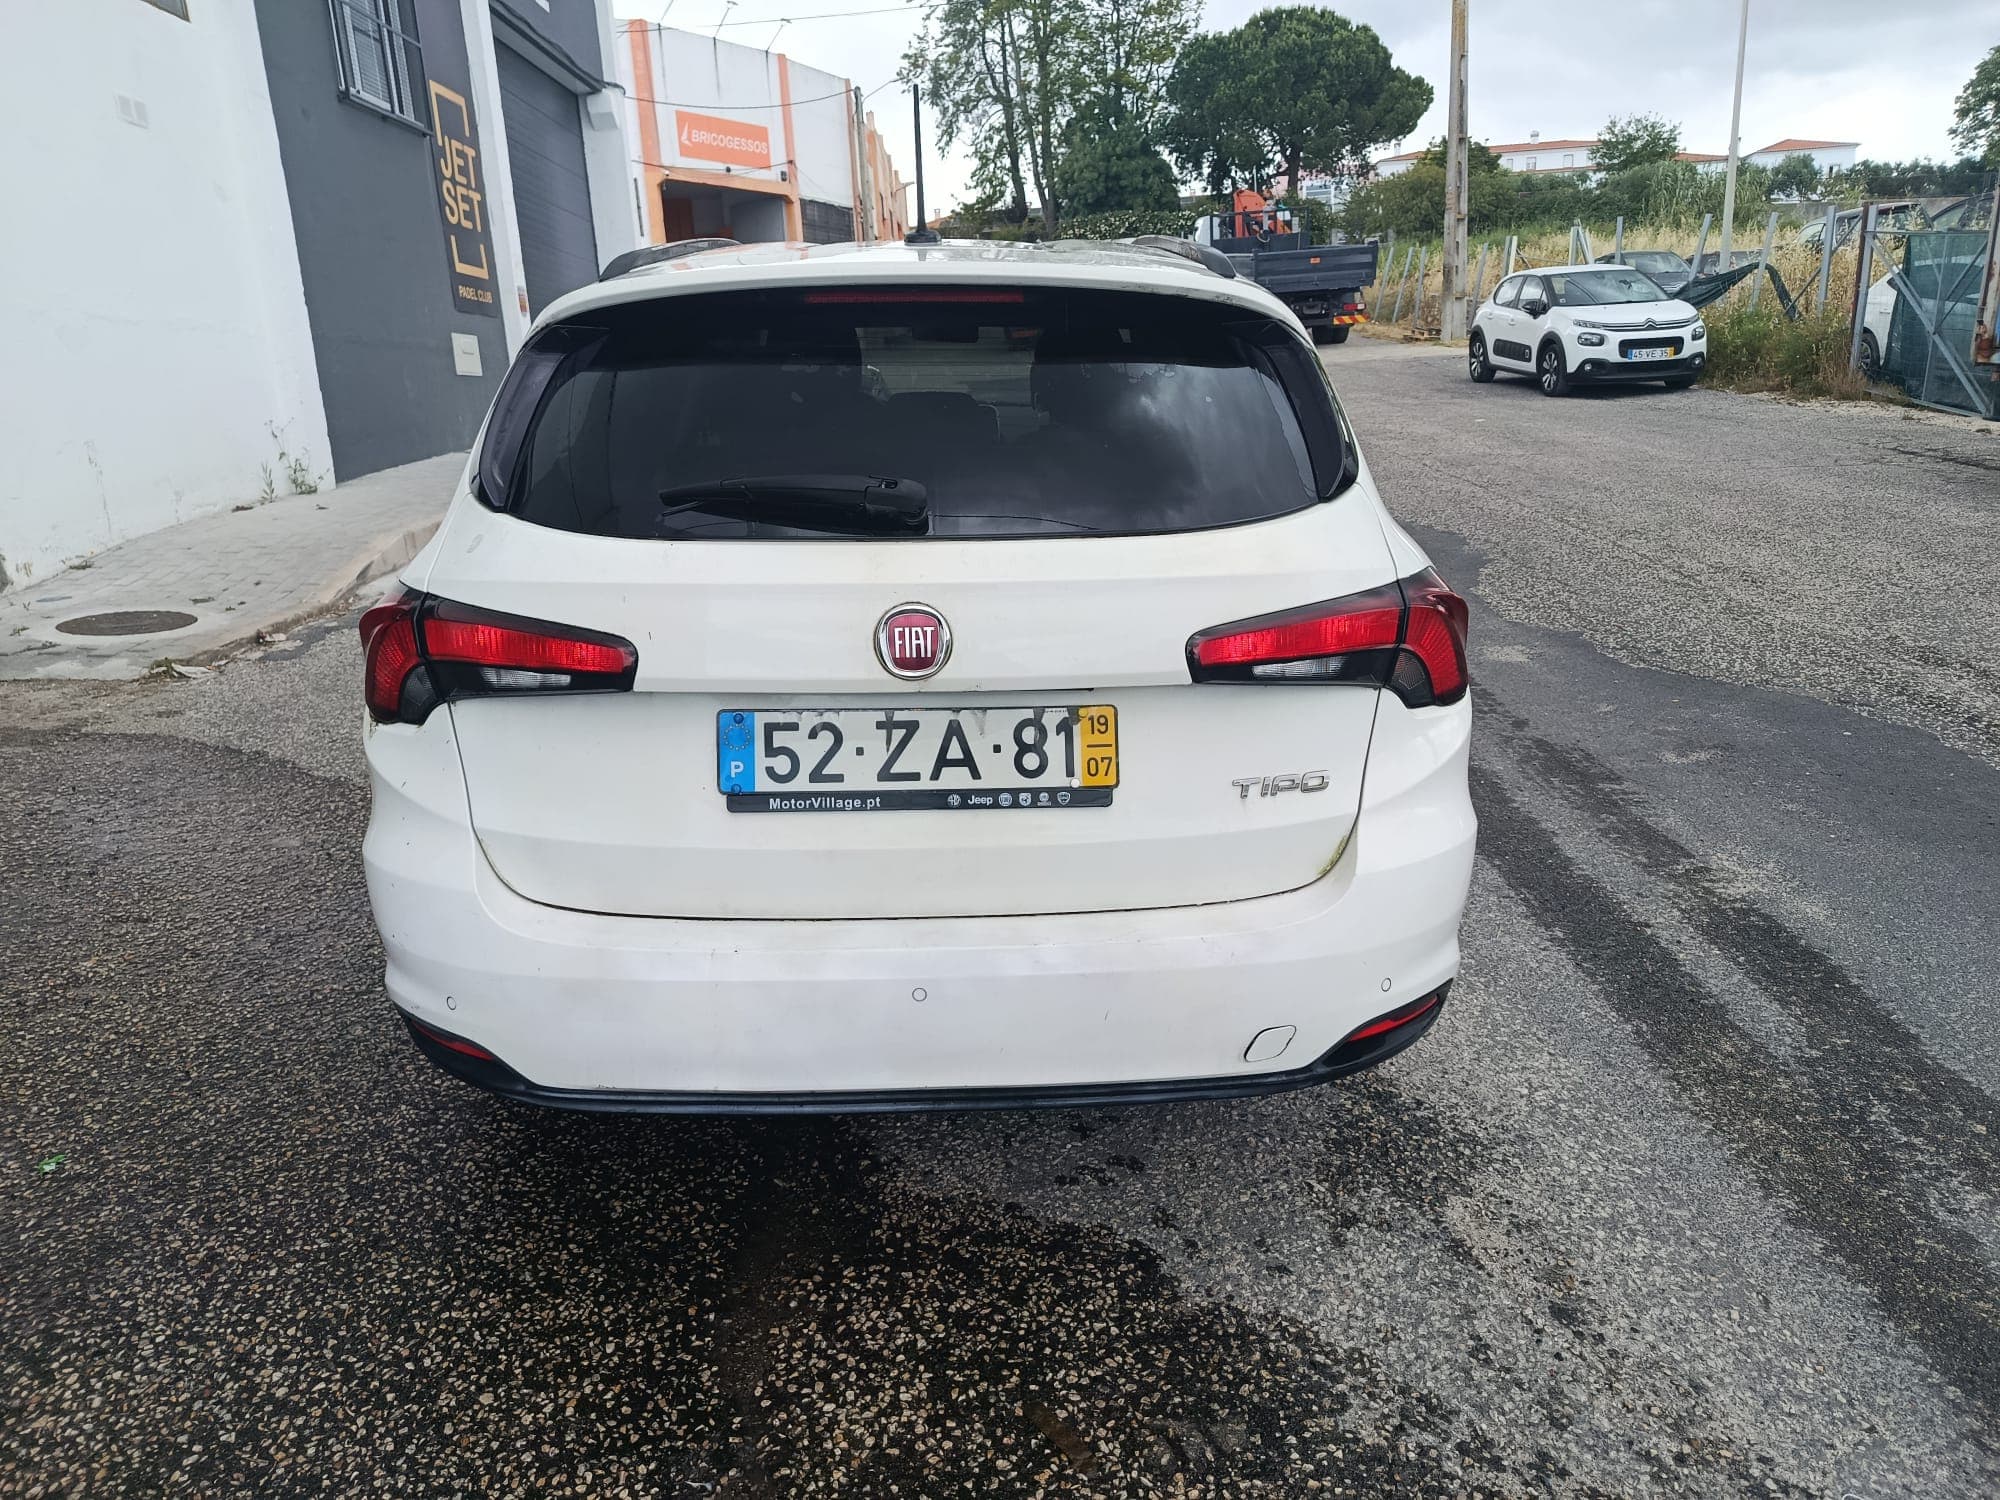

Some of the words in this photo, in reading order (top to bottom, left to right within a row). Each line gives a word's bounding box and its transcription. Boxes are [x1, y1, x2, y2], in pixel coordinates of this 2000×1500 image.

[691, 129, 768, 154] BRICOGESSOS
[440, 135, 476, 189] JET
[442, 179, 481, 233] SET
[458, 285, 477, 300] PADEL
[477, 289, 493, 303] CLUB
[894, 626, 936, 658] FIAT
[1087, 714, 1109, 735] 19
[730, 761, 744, 778] P
[1086, 757, 1113, 777] 07
[1231, 769, 1330, 799] TIPO
[769, 796, 881, 810] MotorVillage.pt
[967, 795, 993, 807] Jeep
